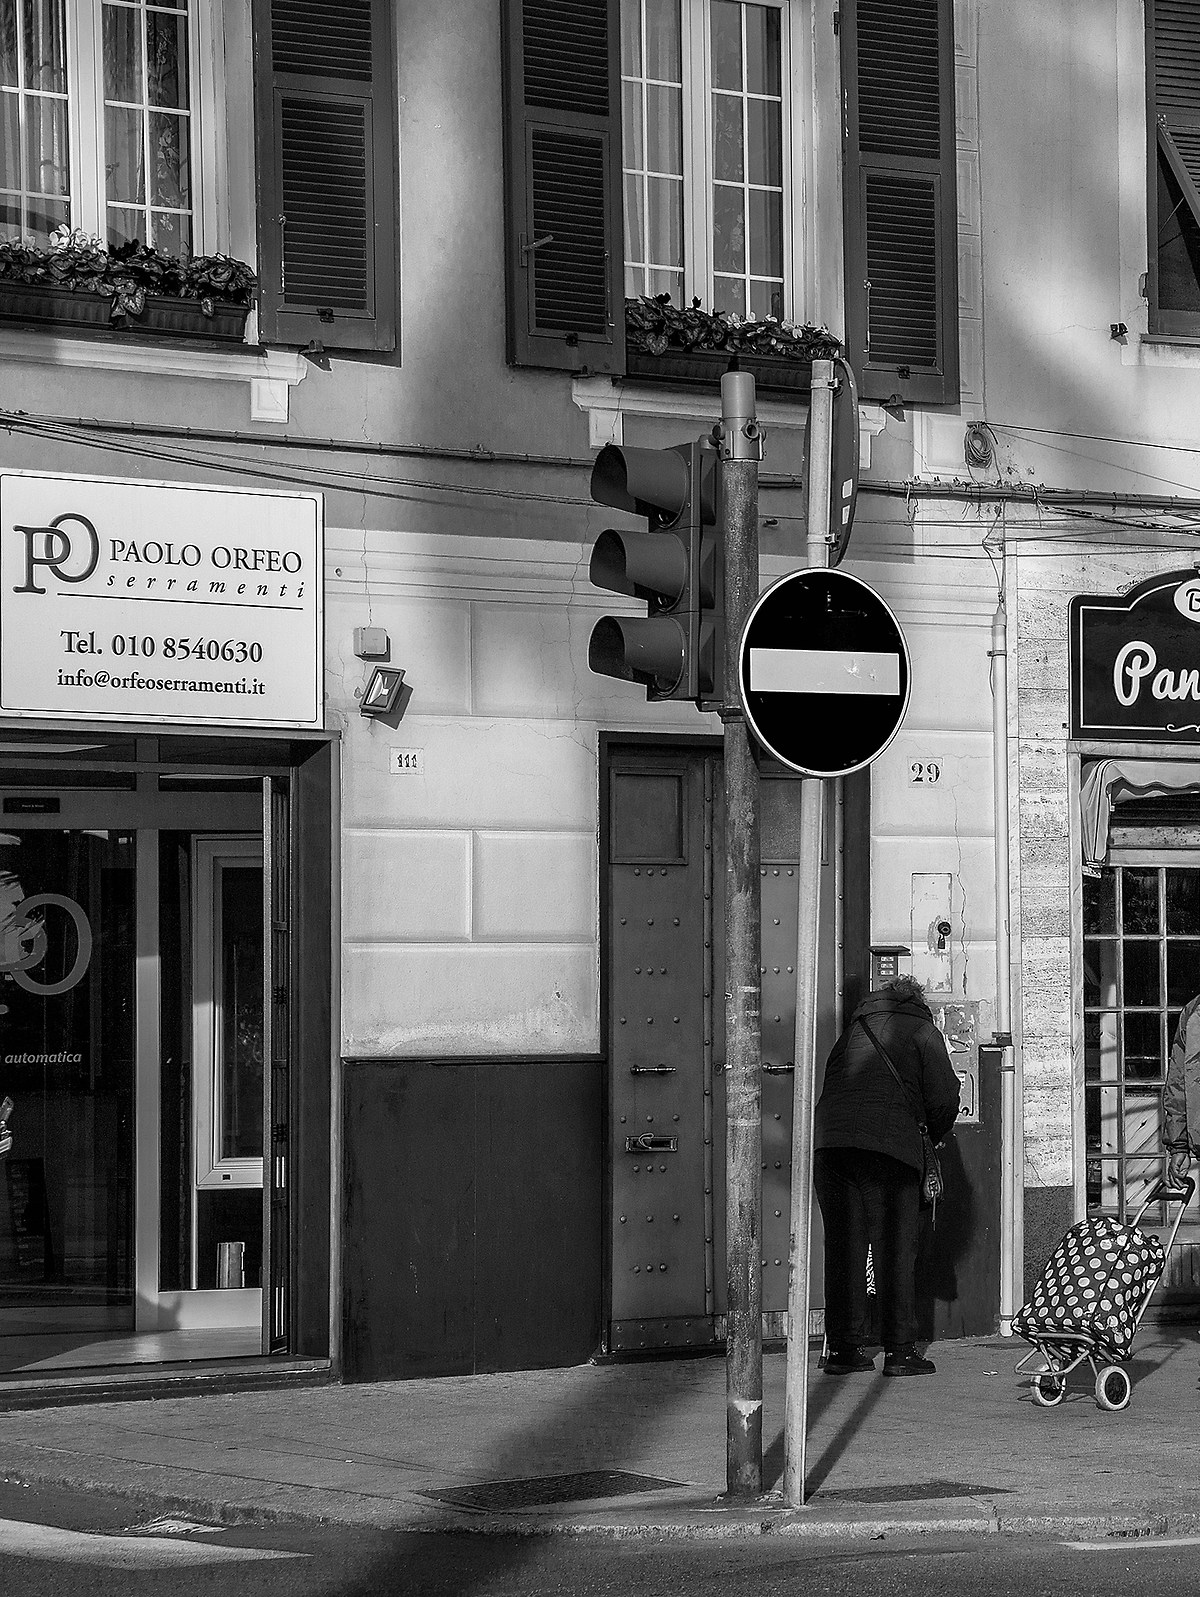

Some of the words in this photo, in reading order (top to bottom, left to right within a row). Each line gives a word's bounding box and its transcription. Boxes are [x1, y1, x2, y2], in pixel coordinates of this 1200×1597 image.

[109, 538, 200, 567] PAOLO
[211, 546, 302, 574] ORFEO
[106, 572, 304, 598] serramenti
[60, 631, 103, 655] Tel.
[111, 634, 155, 657] 010
[163, 637, 263, 663] 8540630
[57, 669, 265, 696] info@orfeoserramenti.it
[396, 753, 418, 768] 111
[911, 762, 940, 783] 29
[4, 1050, 82, 1065] automatica
